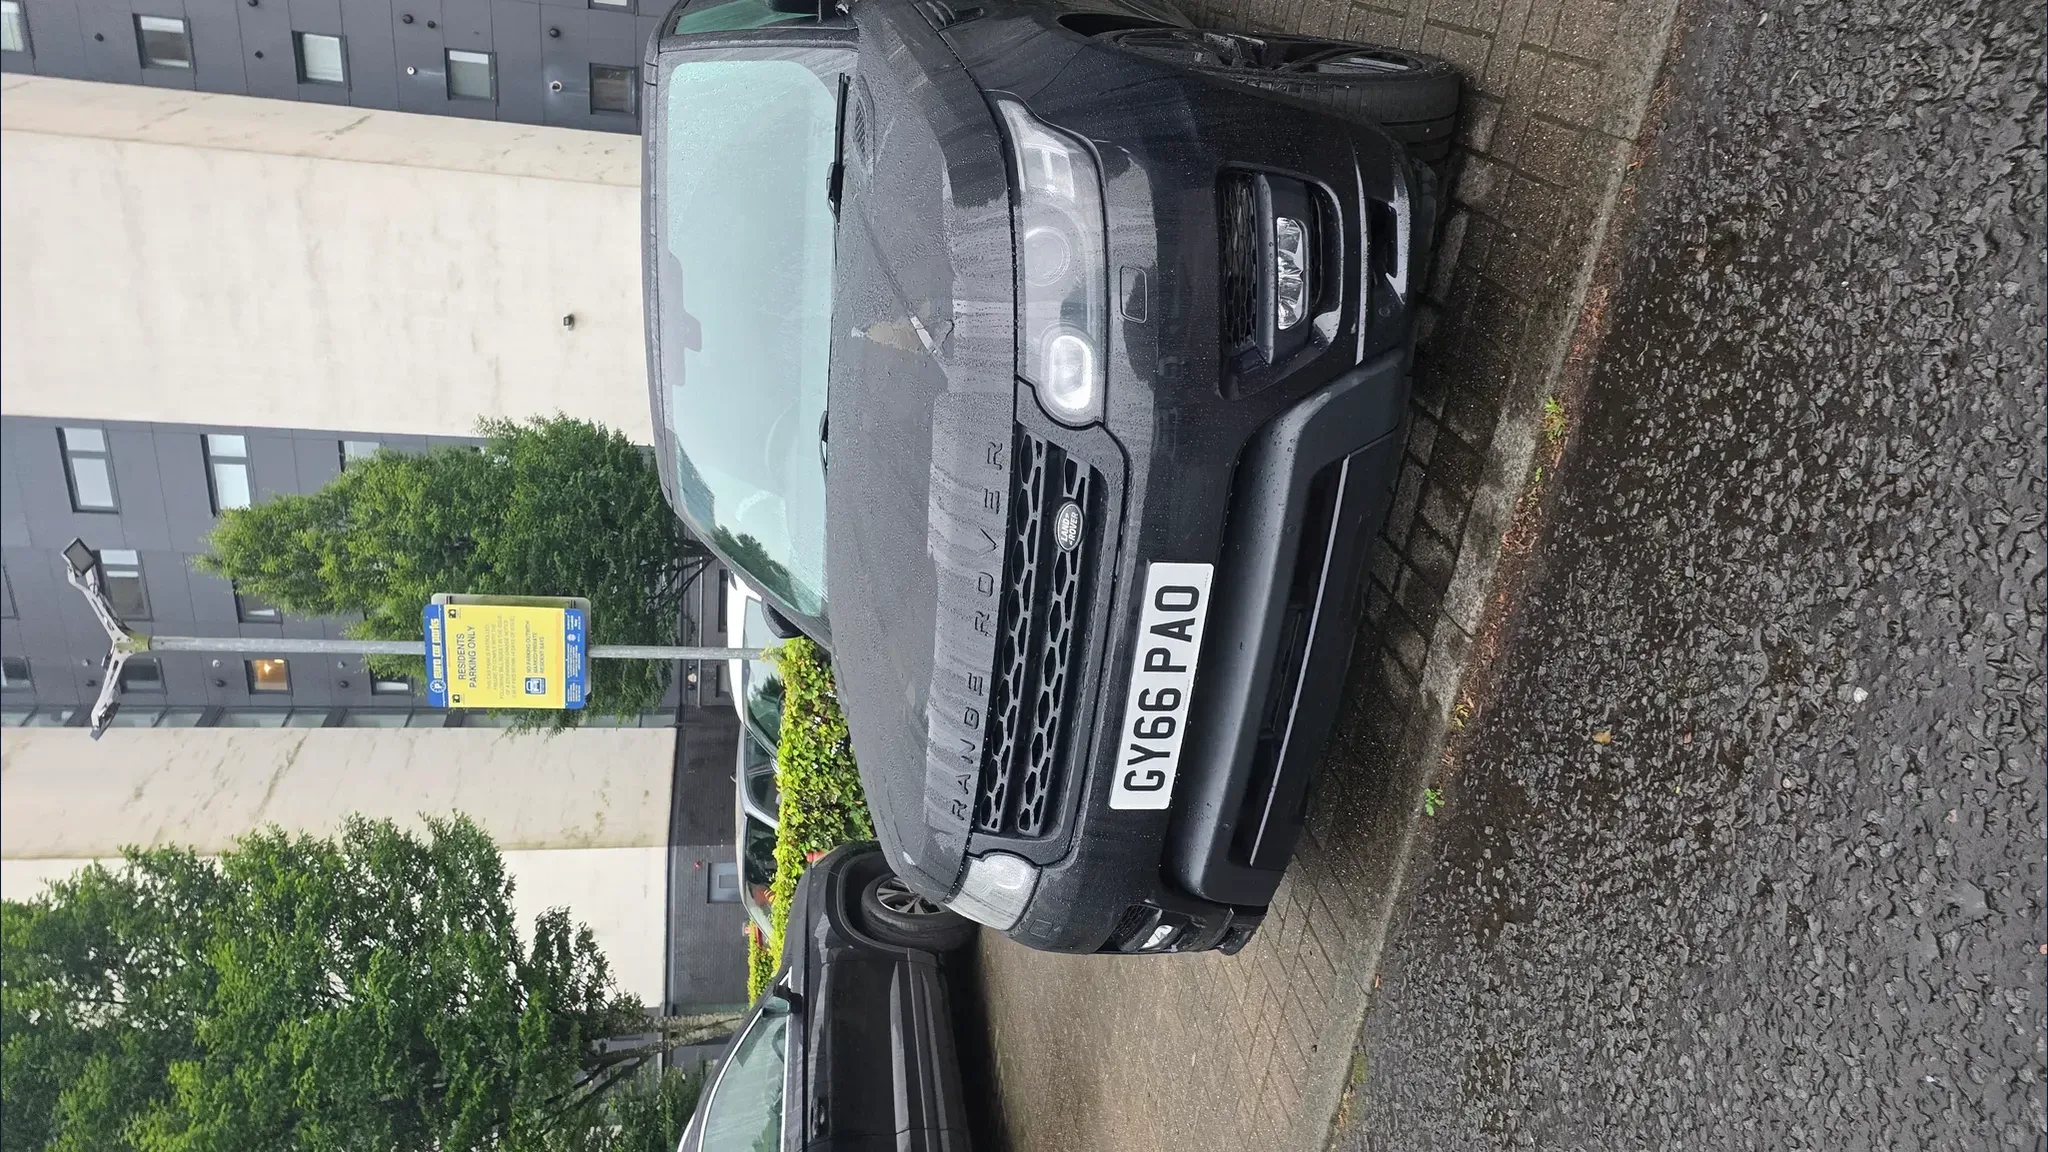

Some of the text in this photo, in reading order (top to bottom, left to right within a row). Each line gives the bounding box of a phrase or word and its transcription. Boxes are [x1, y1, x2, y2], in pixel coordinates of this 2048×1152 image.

[1061, 518, 1070, 542] LAND
[1068, 512, 1078, 541] ROVER
[457, 633, 466, 680] RESIDENTS
[951, 438, 1003, 821] RANGE ROVER
[467, 626, 477, 688] PARKING ONLY
[1123, 585, 1200, 792] GY66 PAO
